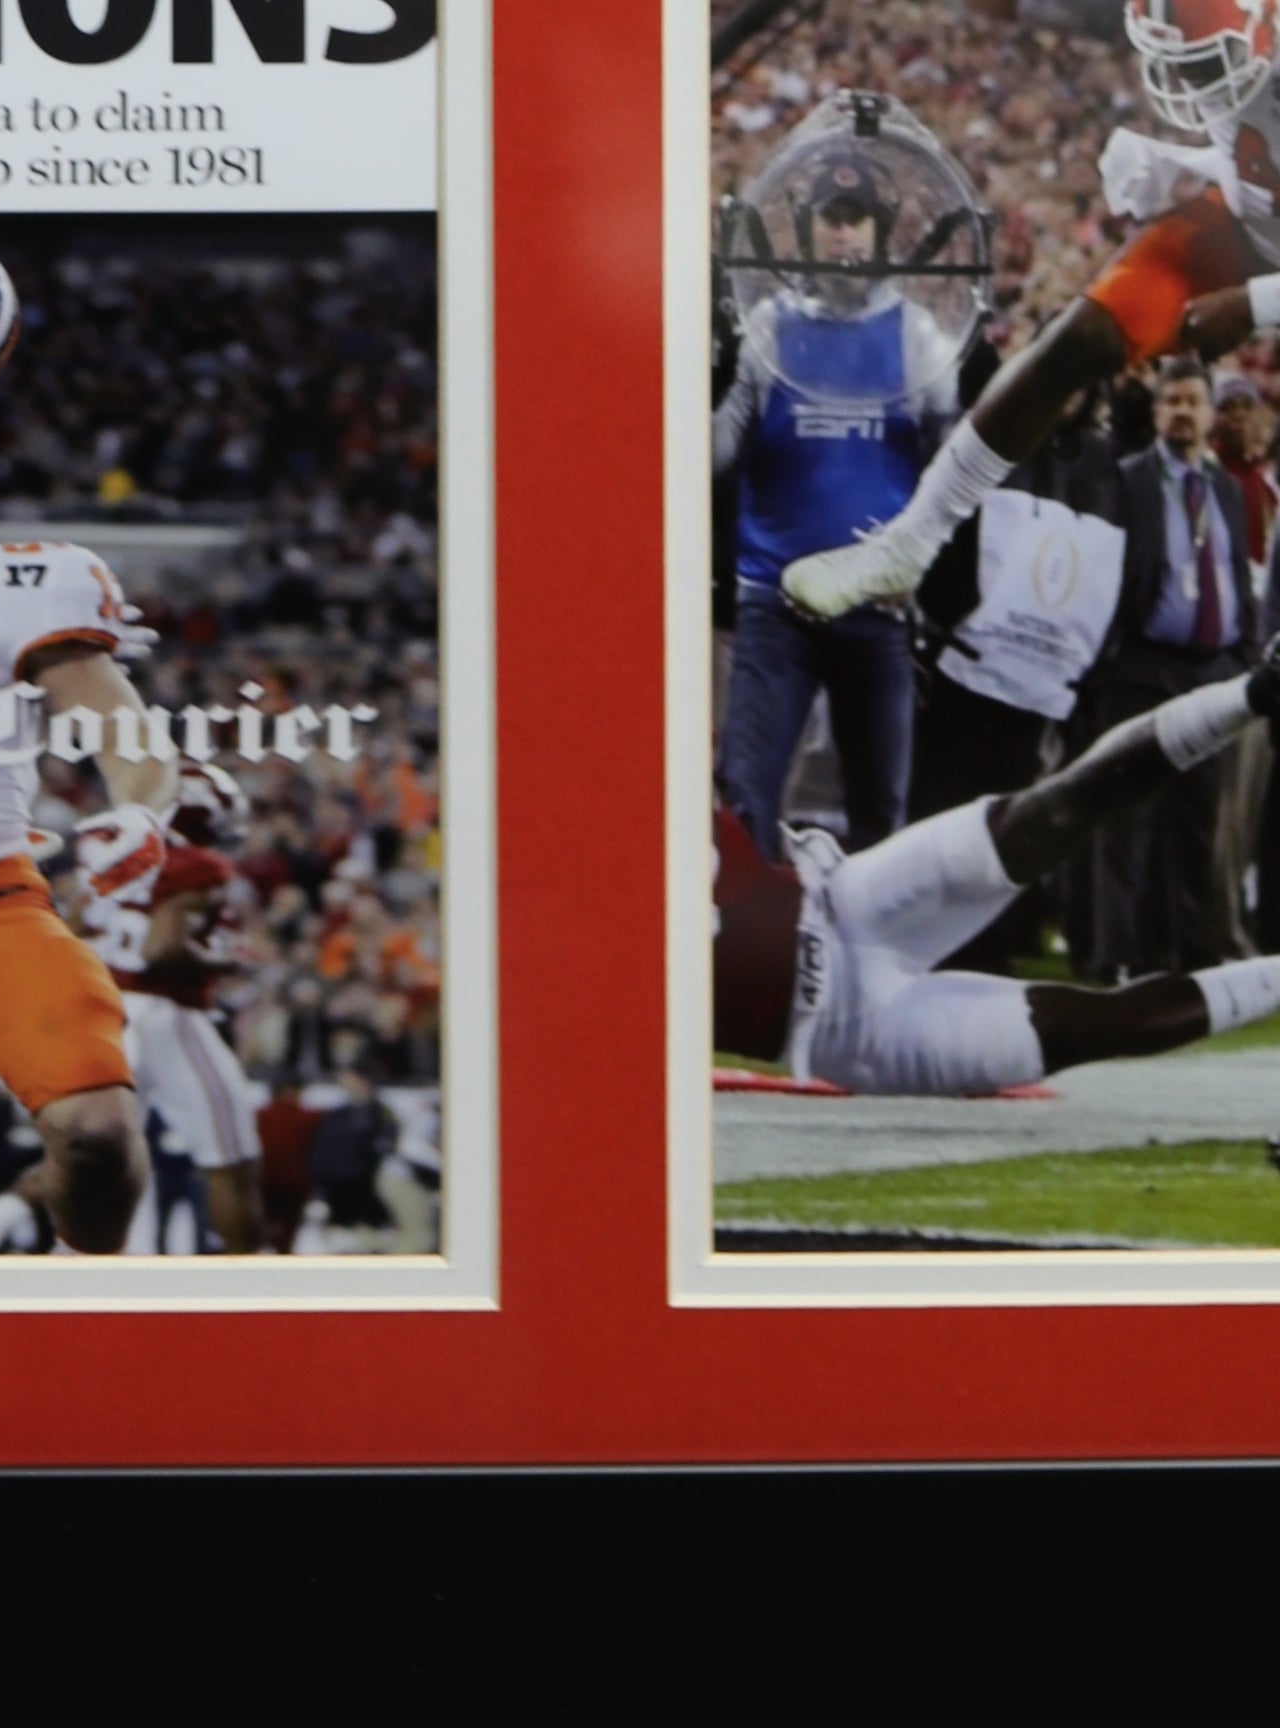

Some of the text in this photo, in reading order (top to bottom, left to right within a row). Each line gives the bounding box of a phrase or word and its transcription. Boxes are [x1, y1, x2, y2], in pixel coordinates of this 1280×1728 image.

[31, 98, 80, 132] to
[94, 91, 226, 132] claim
[27, 147, 150, 186] since
[169, 147, 264, 186] 1981
